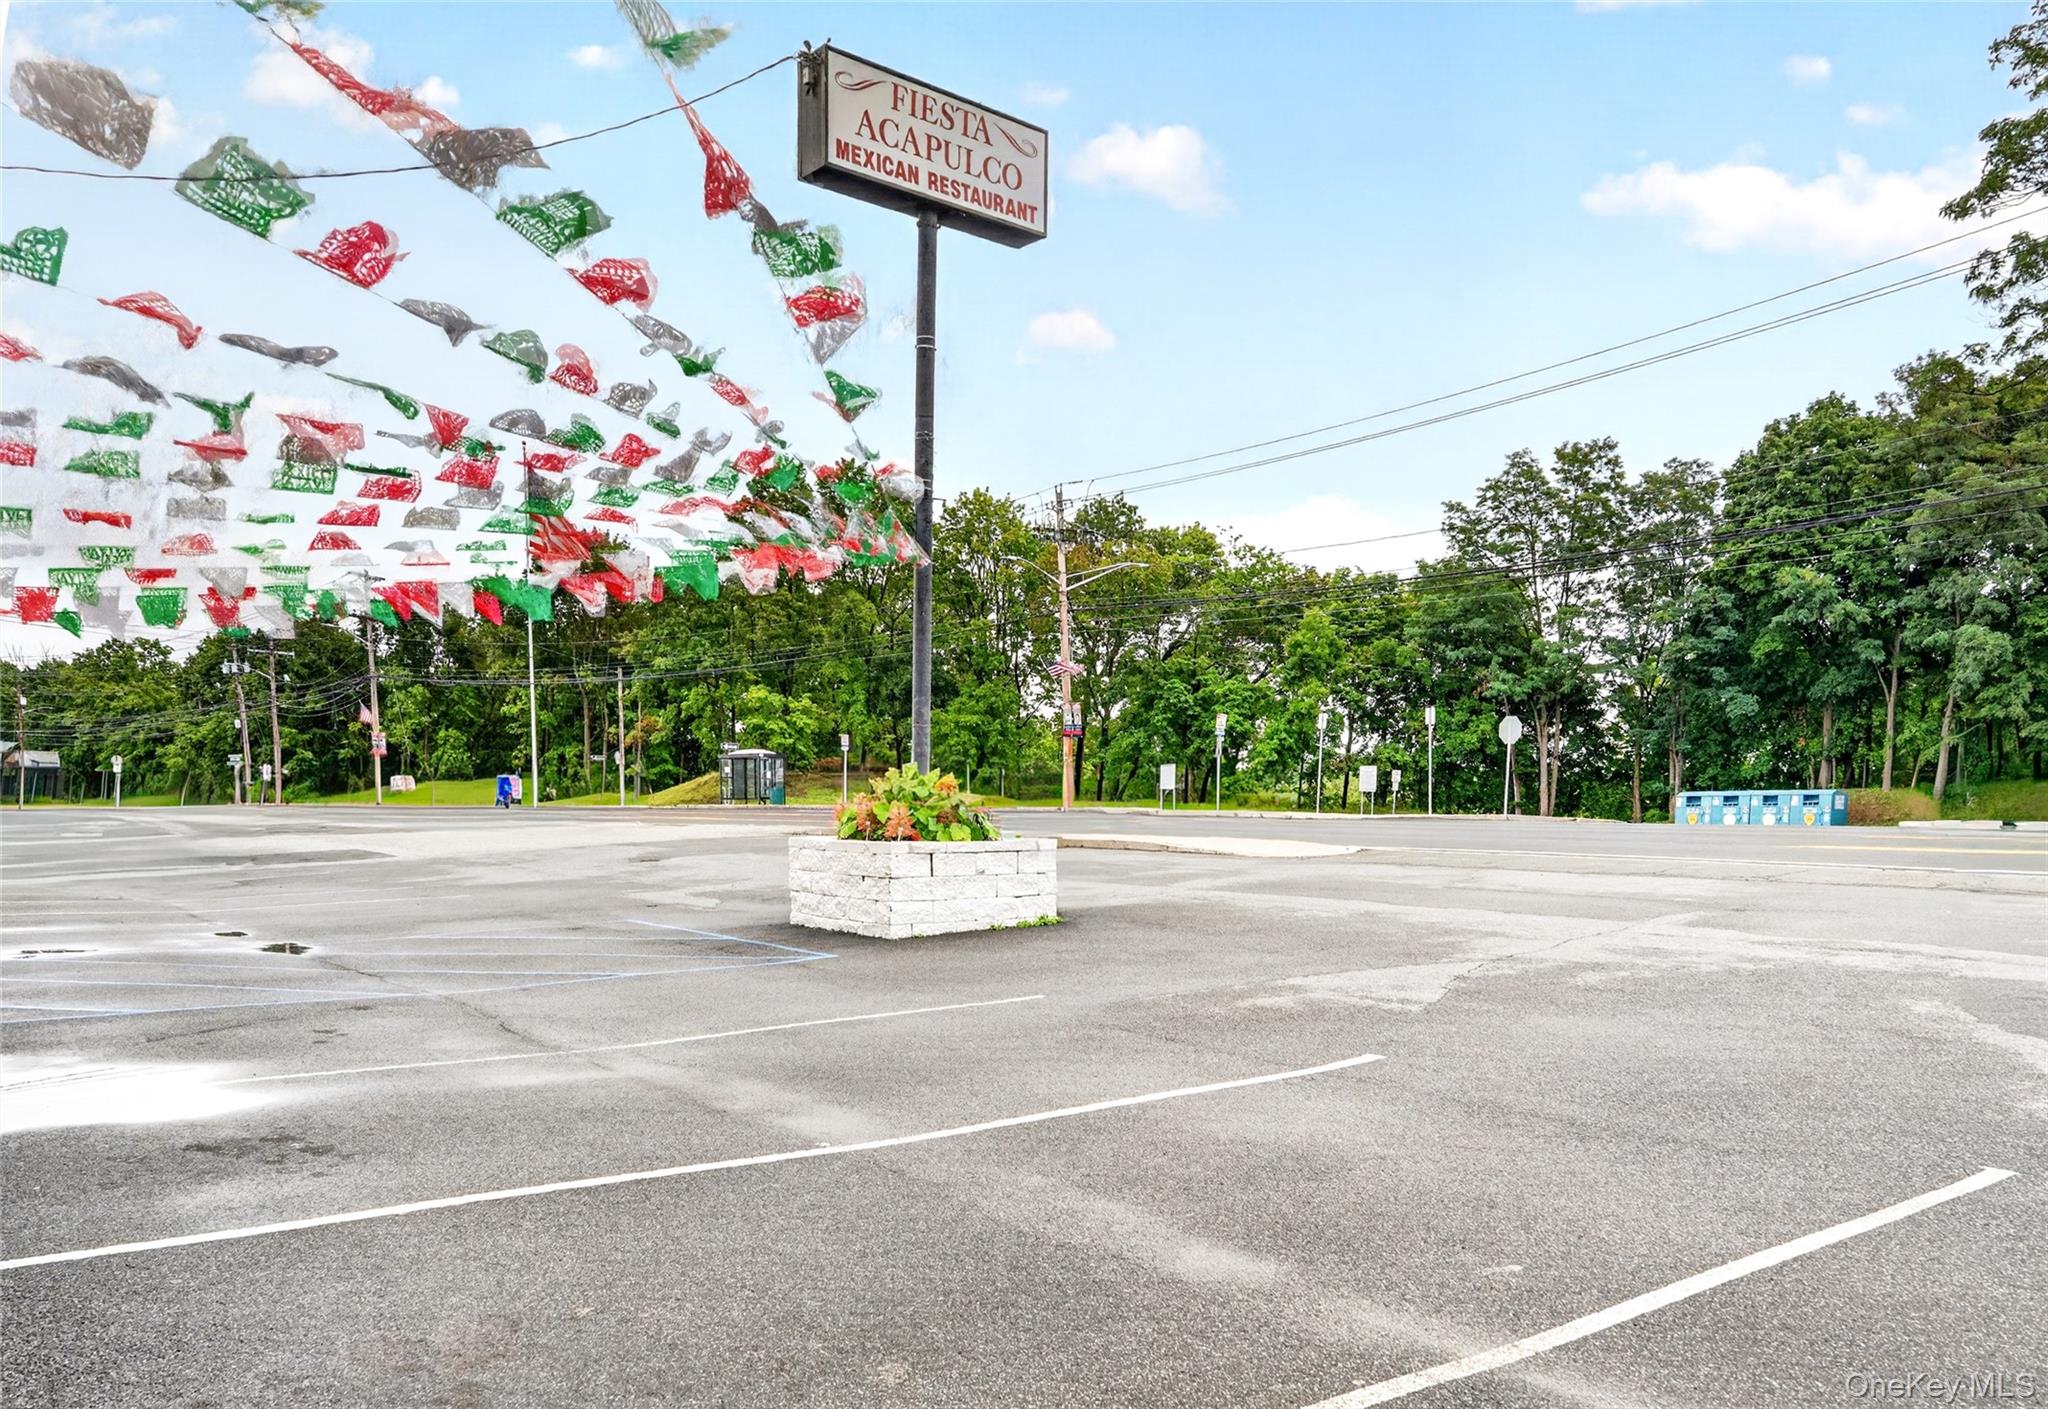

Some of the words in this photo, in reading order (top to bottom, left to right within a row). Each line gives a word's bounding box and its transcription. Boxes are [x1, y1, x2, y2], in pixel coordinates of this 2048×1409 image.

[855, 109, 1023, 191] ACAPULCO
[891, 81, 994, 146] FIESTA
[835, 137, 920, 186] MEXICAN
[927, 170, 1038, 224] RESTAURANT
